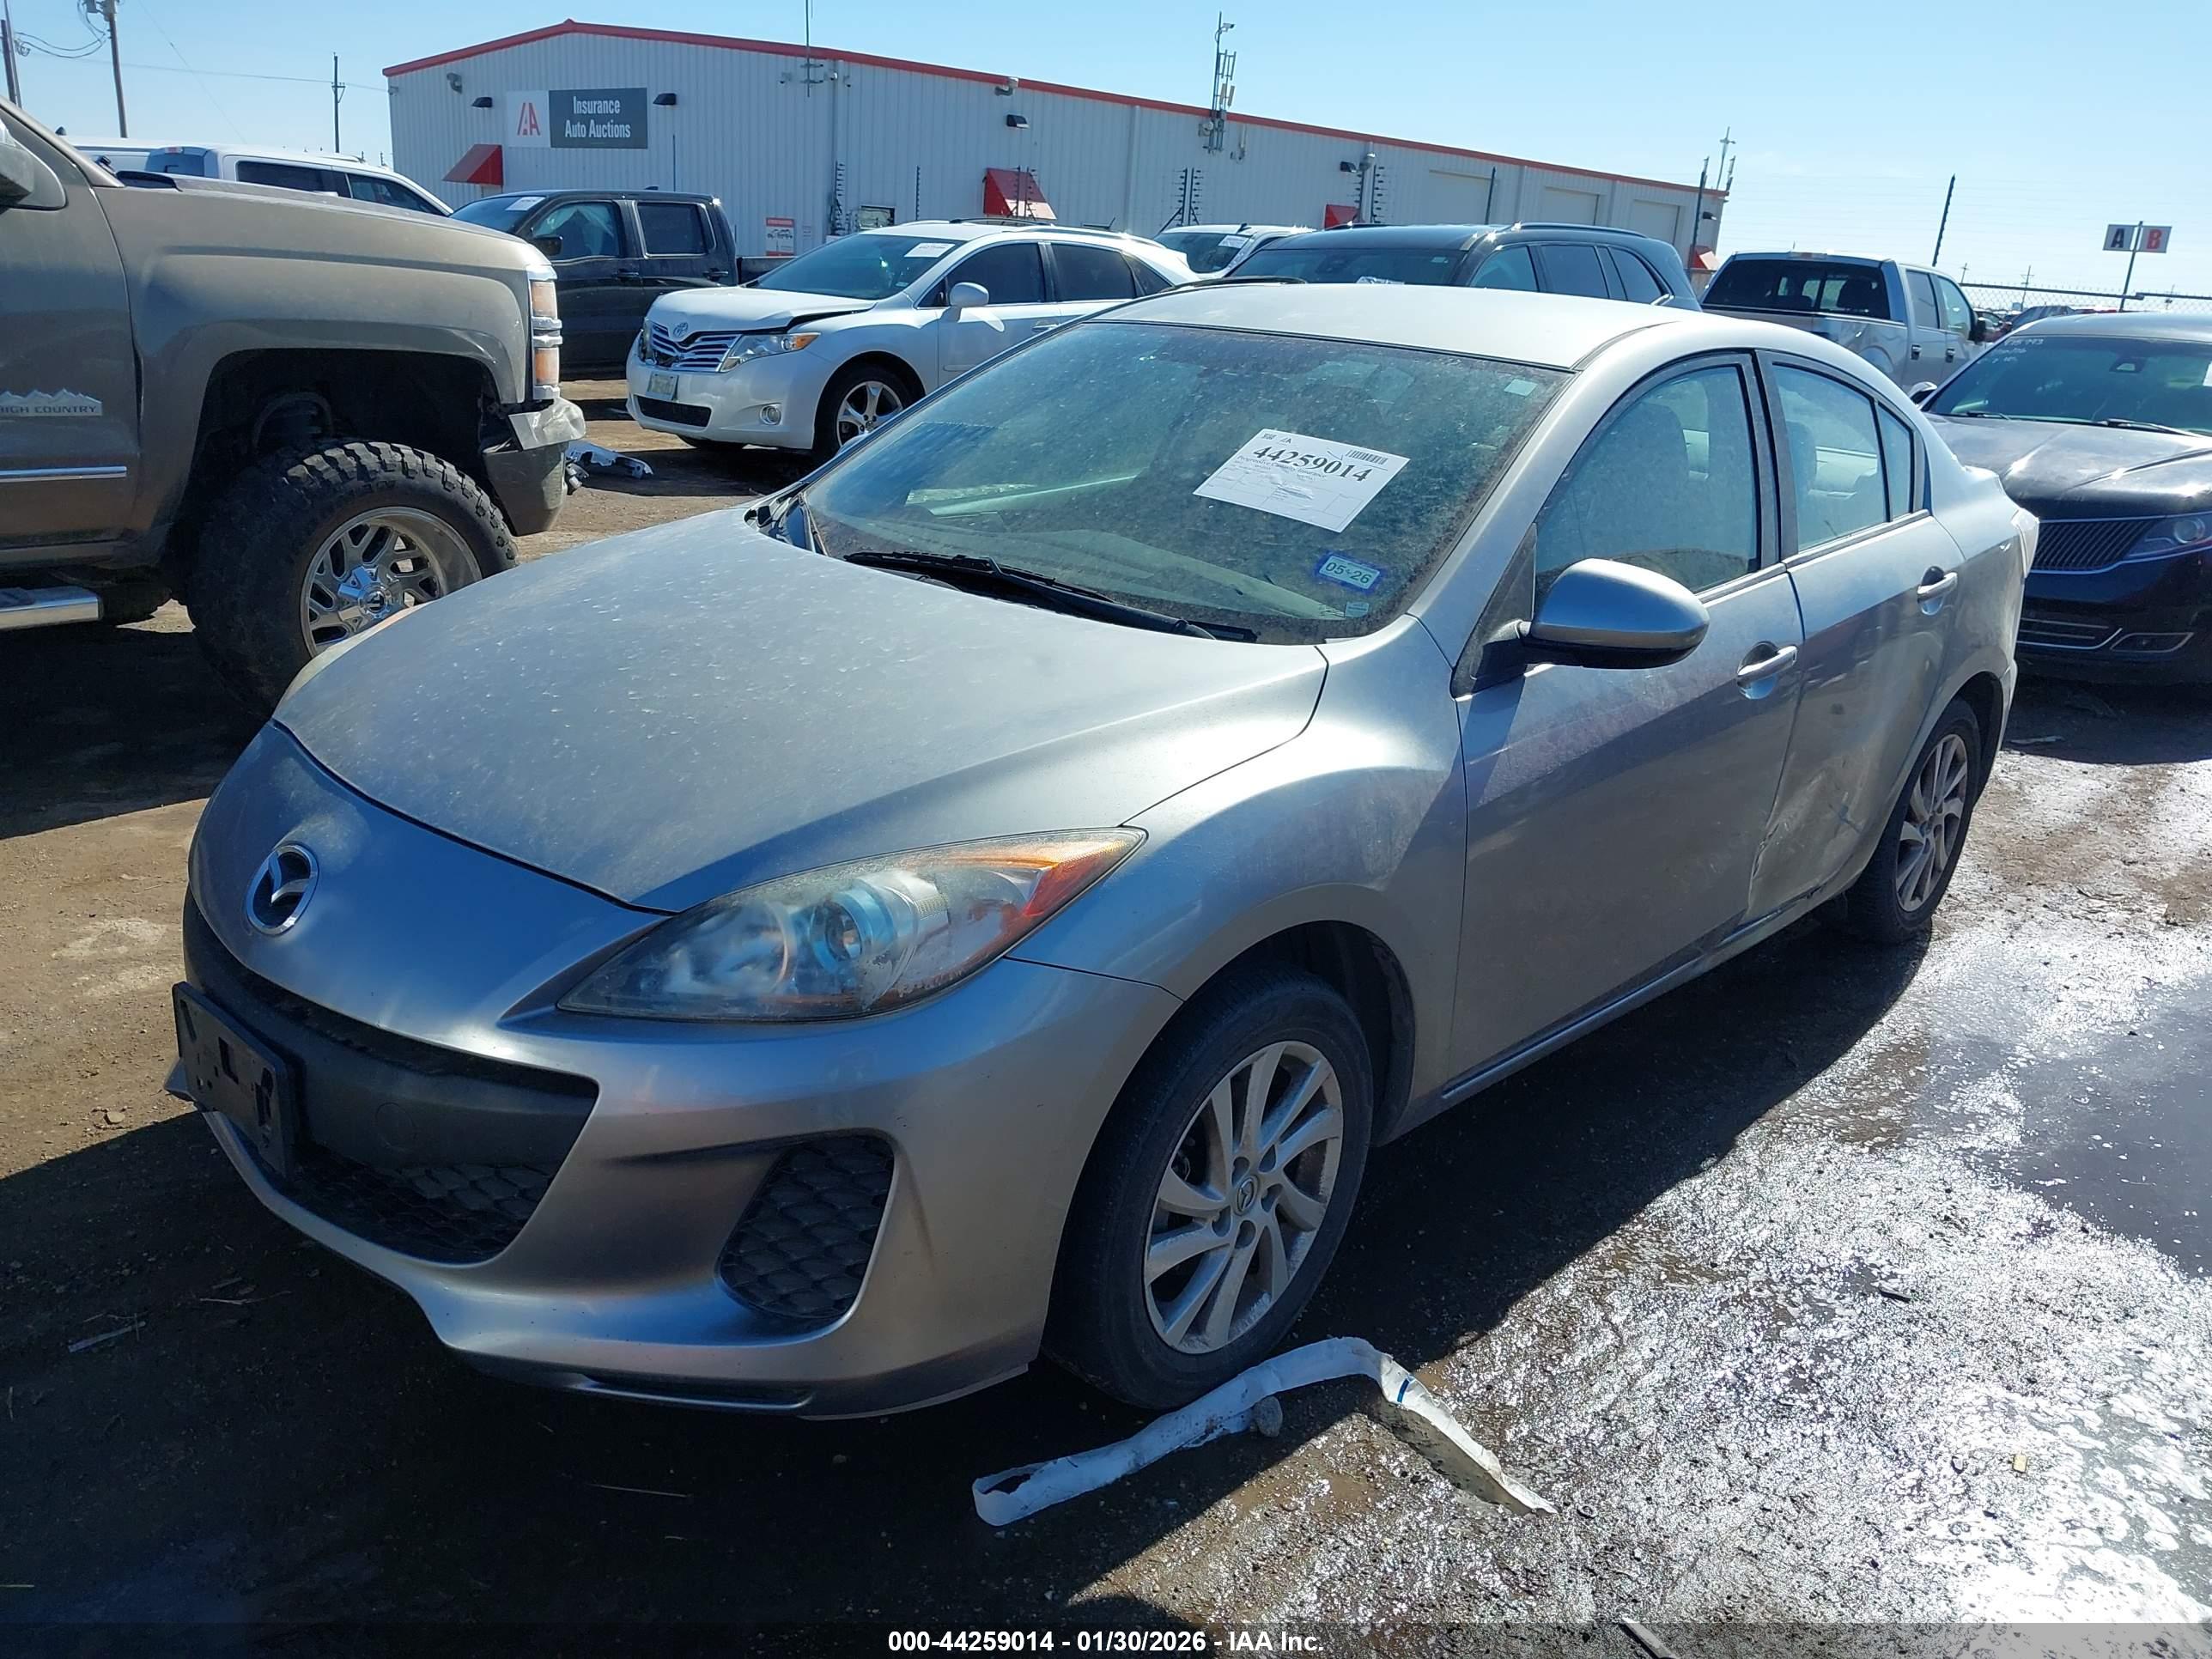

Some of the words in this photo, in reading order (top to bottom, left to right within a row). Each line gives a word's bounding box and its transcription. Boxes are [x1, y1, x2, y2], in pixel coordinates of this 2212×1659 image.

[573, 95, 621, 114] Insurance
[564, 119, 586, 138] Auto
[588, 118, 631, 138] Auctions
[2110, 228, 2125, 248] A
[2146, 228, 2163, 249] B
[1253, 446, 1373, 482] 44259014
